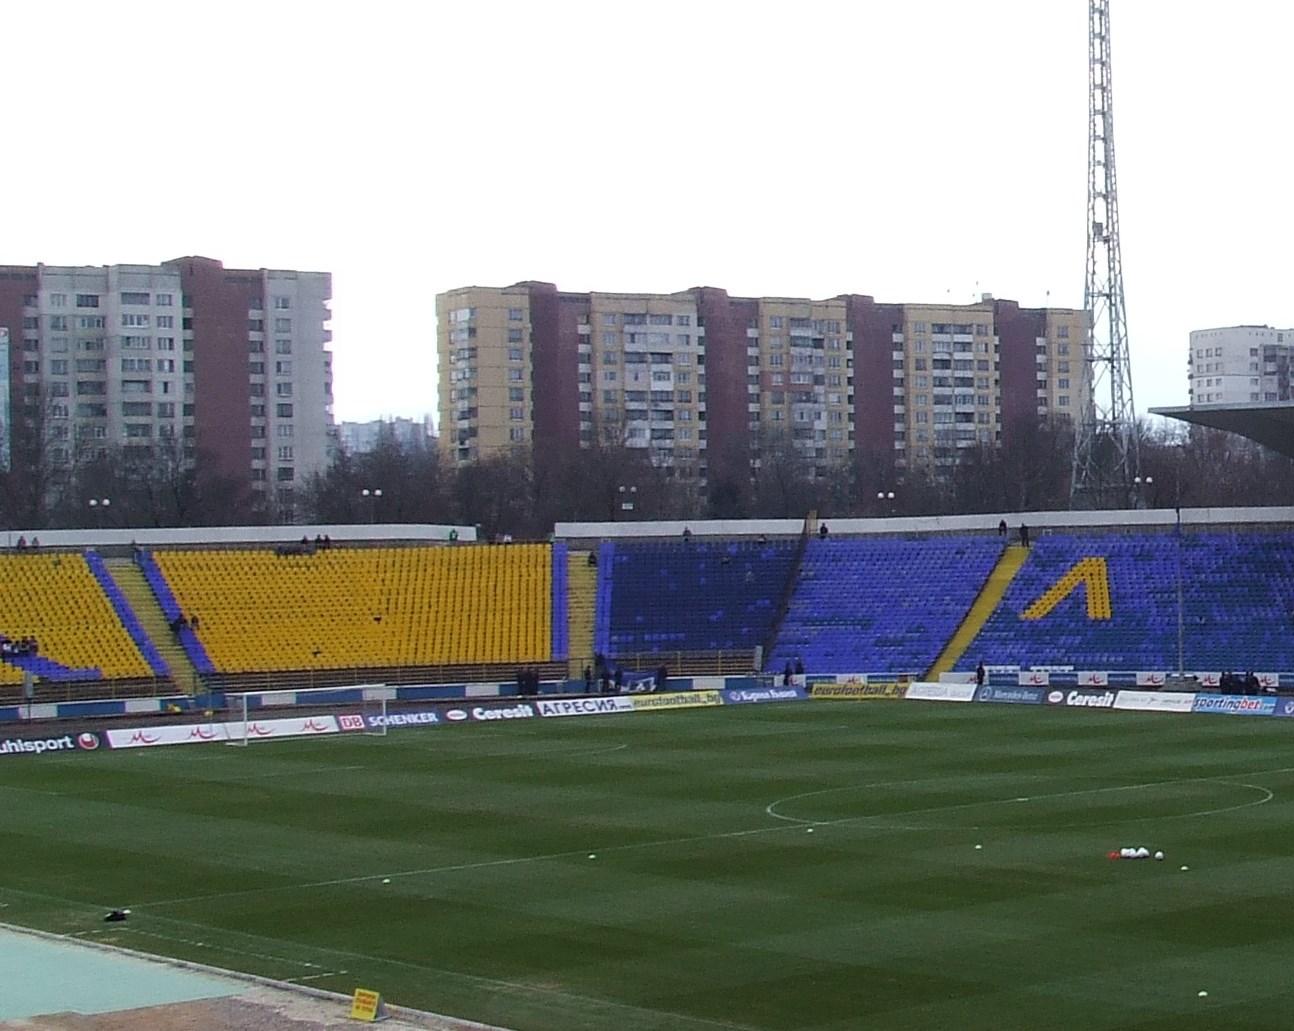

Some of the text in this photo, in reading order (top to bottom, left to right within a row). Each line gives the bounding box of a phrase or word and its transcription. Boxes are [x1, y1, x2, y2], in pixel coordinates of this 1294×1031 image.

[542, 699, 618, 716] АГРЕСИЯ
[1067, 691, 1115, 707] Ceresit
[342, 715, 363, 728] DB
[368, 712, 439, 727] SCHENKER
[473, 704, 534, 721] Ceresit
[0, 735, 75, 754] uhlsport
